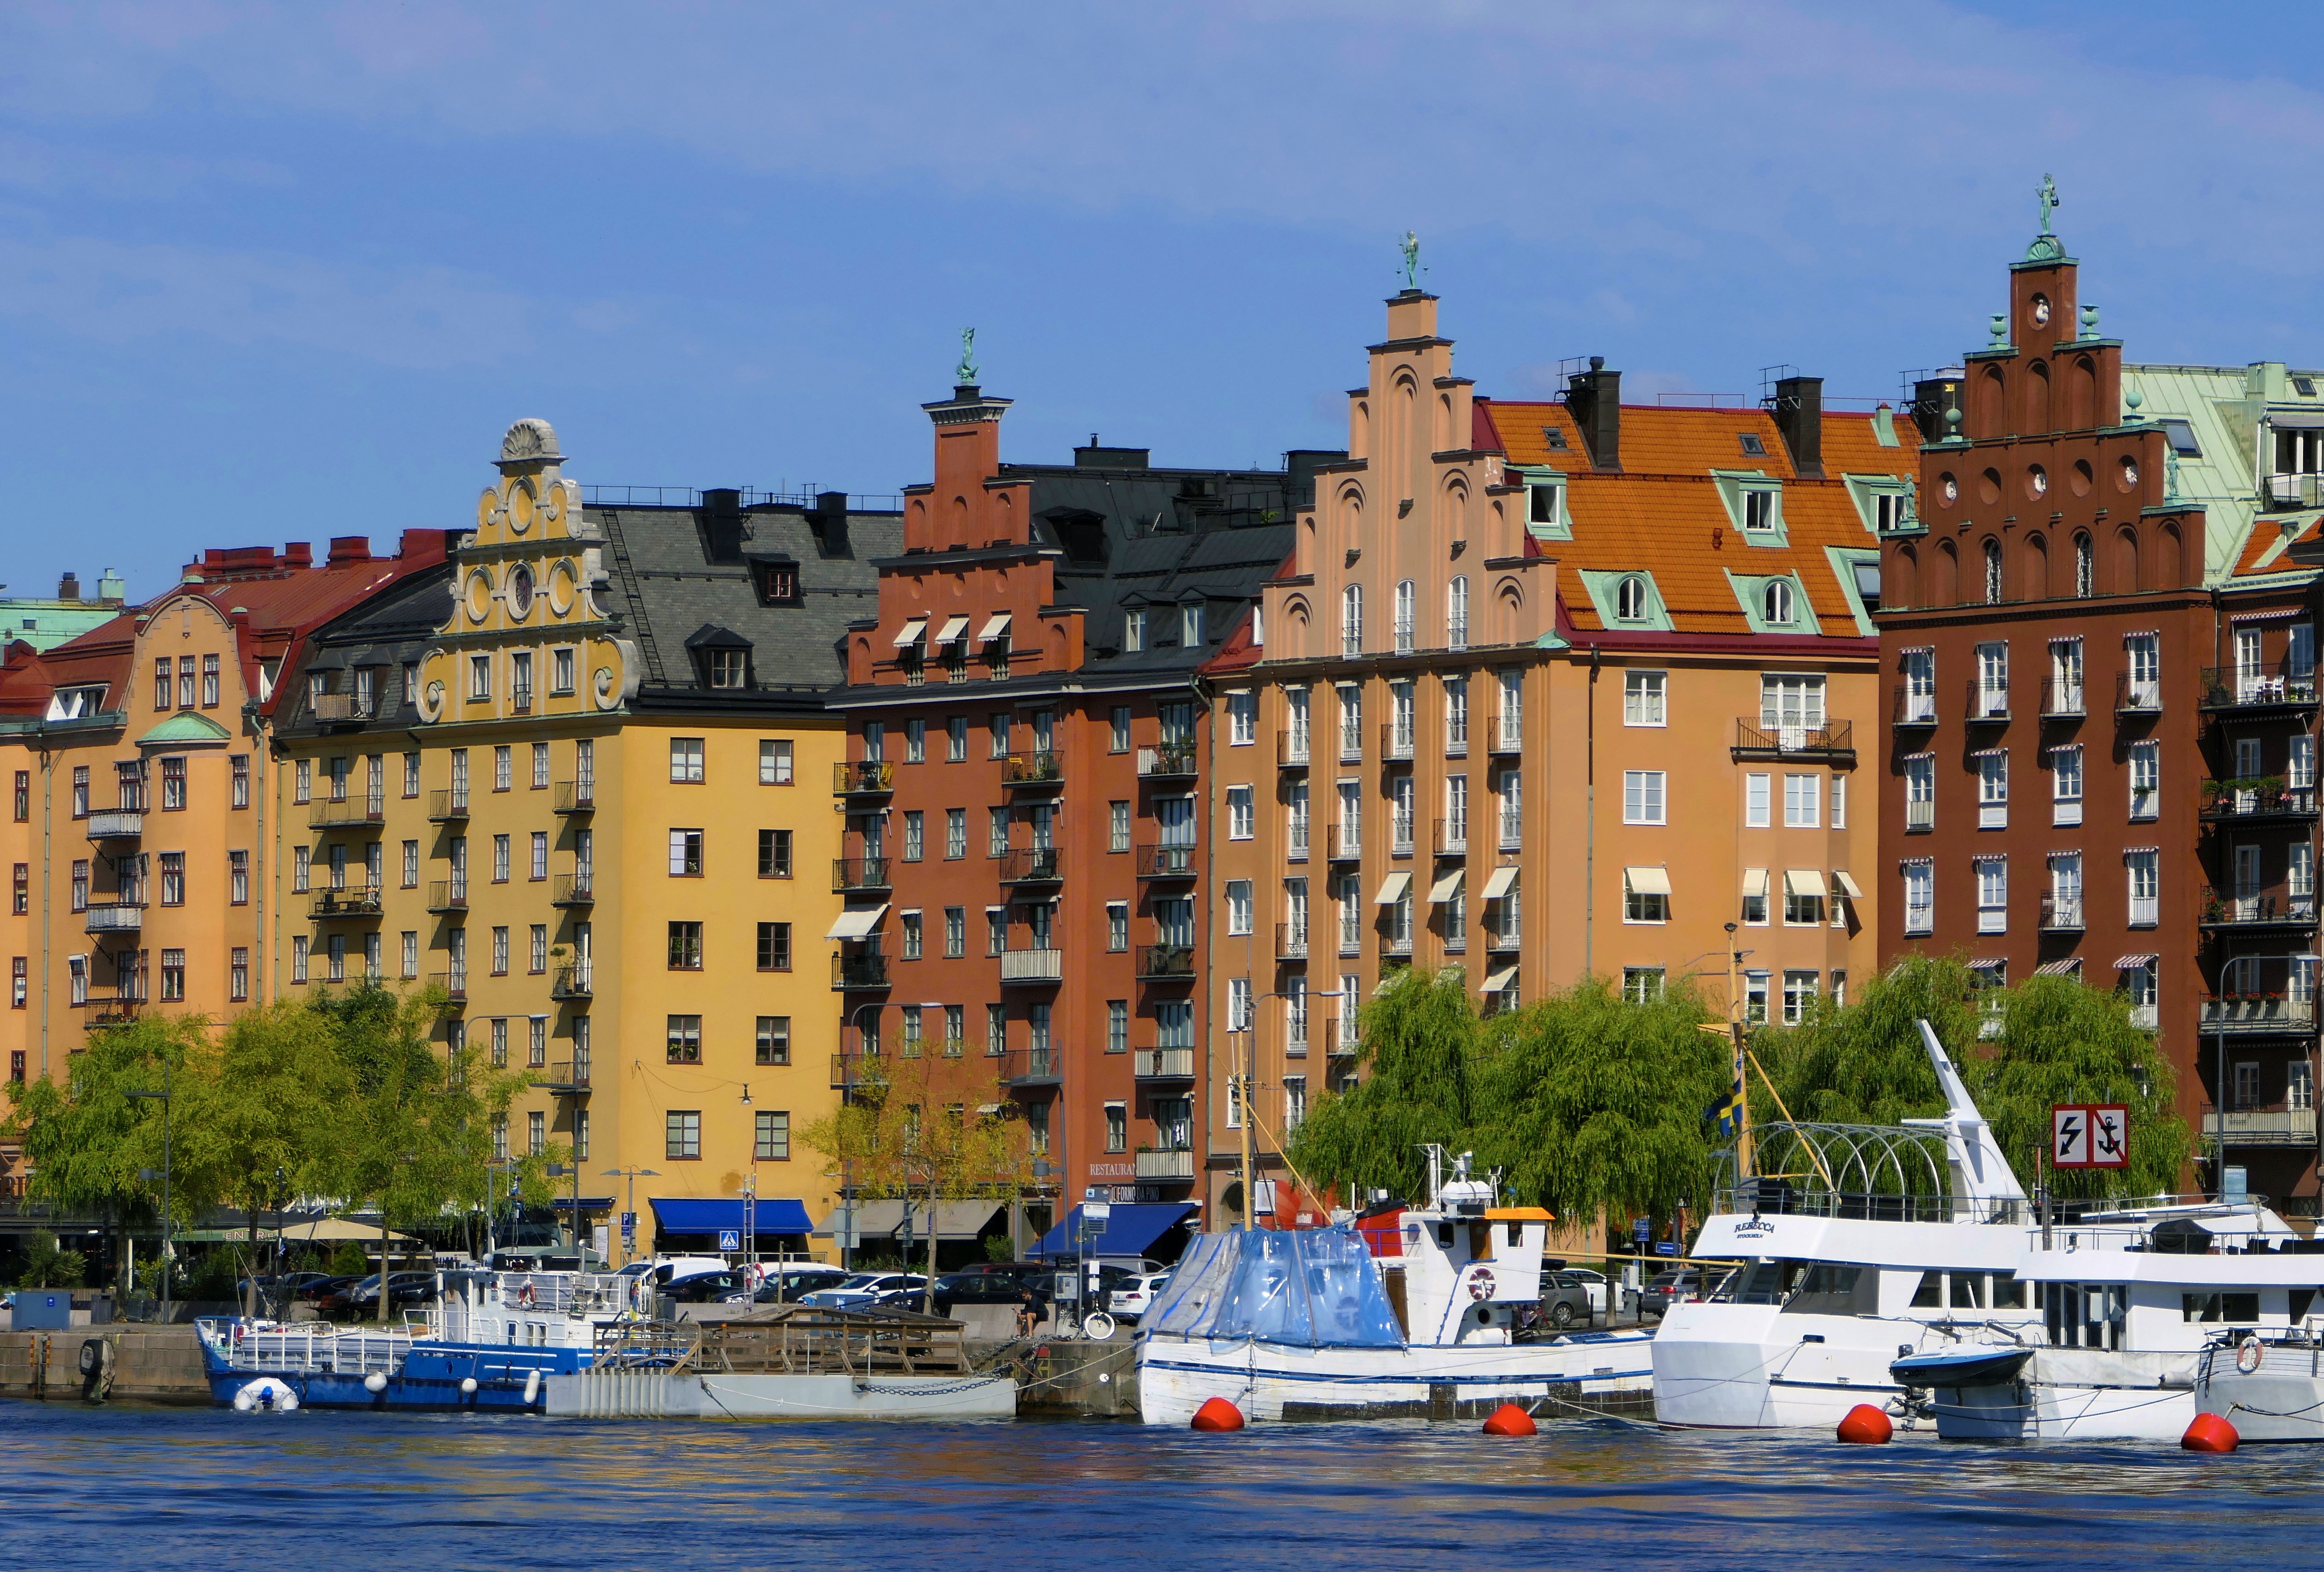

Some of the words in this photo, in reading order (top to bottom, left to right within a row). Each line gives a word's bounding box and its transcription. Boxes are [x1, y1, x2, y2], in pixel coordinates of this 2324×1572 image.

[1117, 1186, 1136, 1201] FORNO
[1136, 1186, 1145, 1201] DA
[1146, 1186, 1159, 1201] PINO
[623, 1213, 629, 1225] P
[1734, 1221, 1775, 1234] REBECCA
[225, 1229, 274, 1240] ENRE
